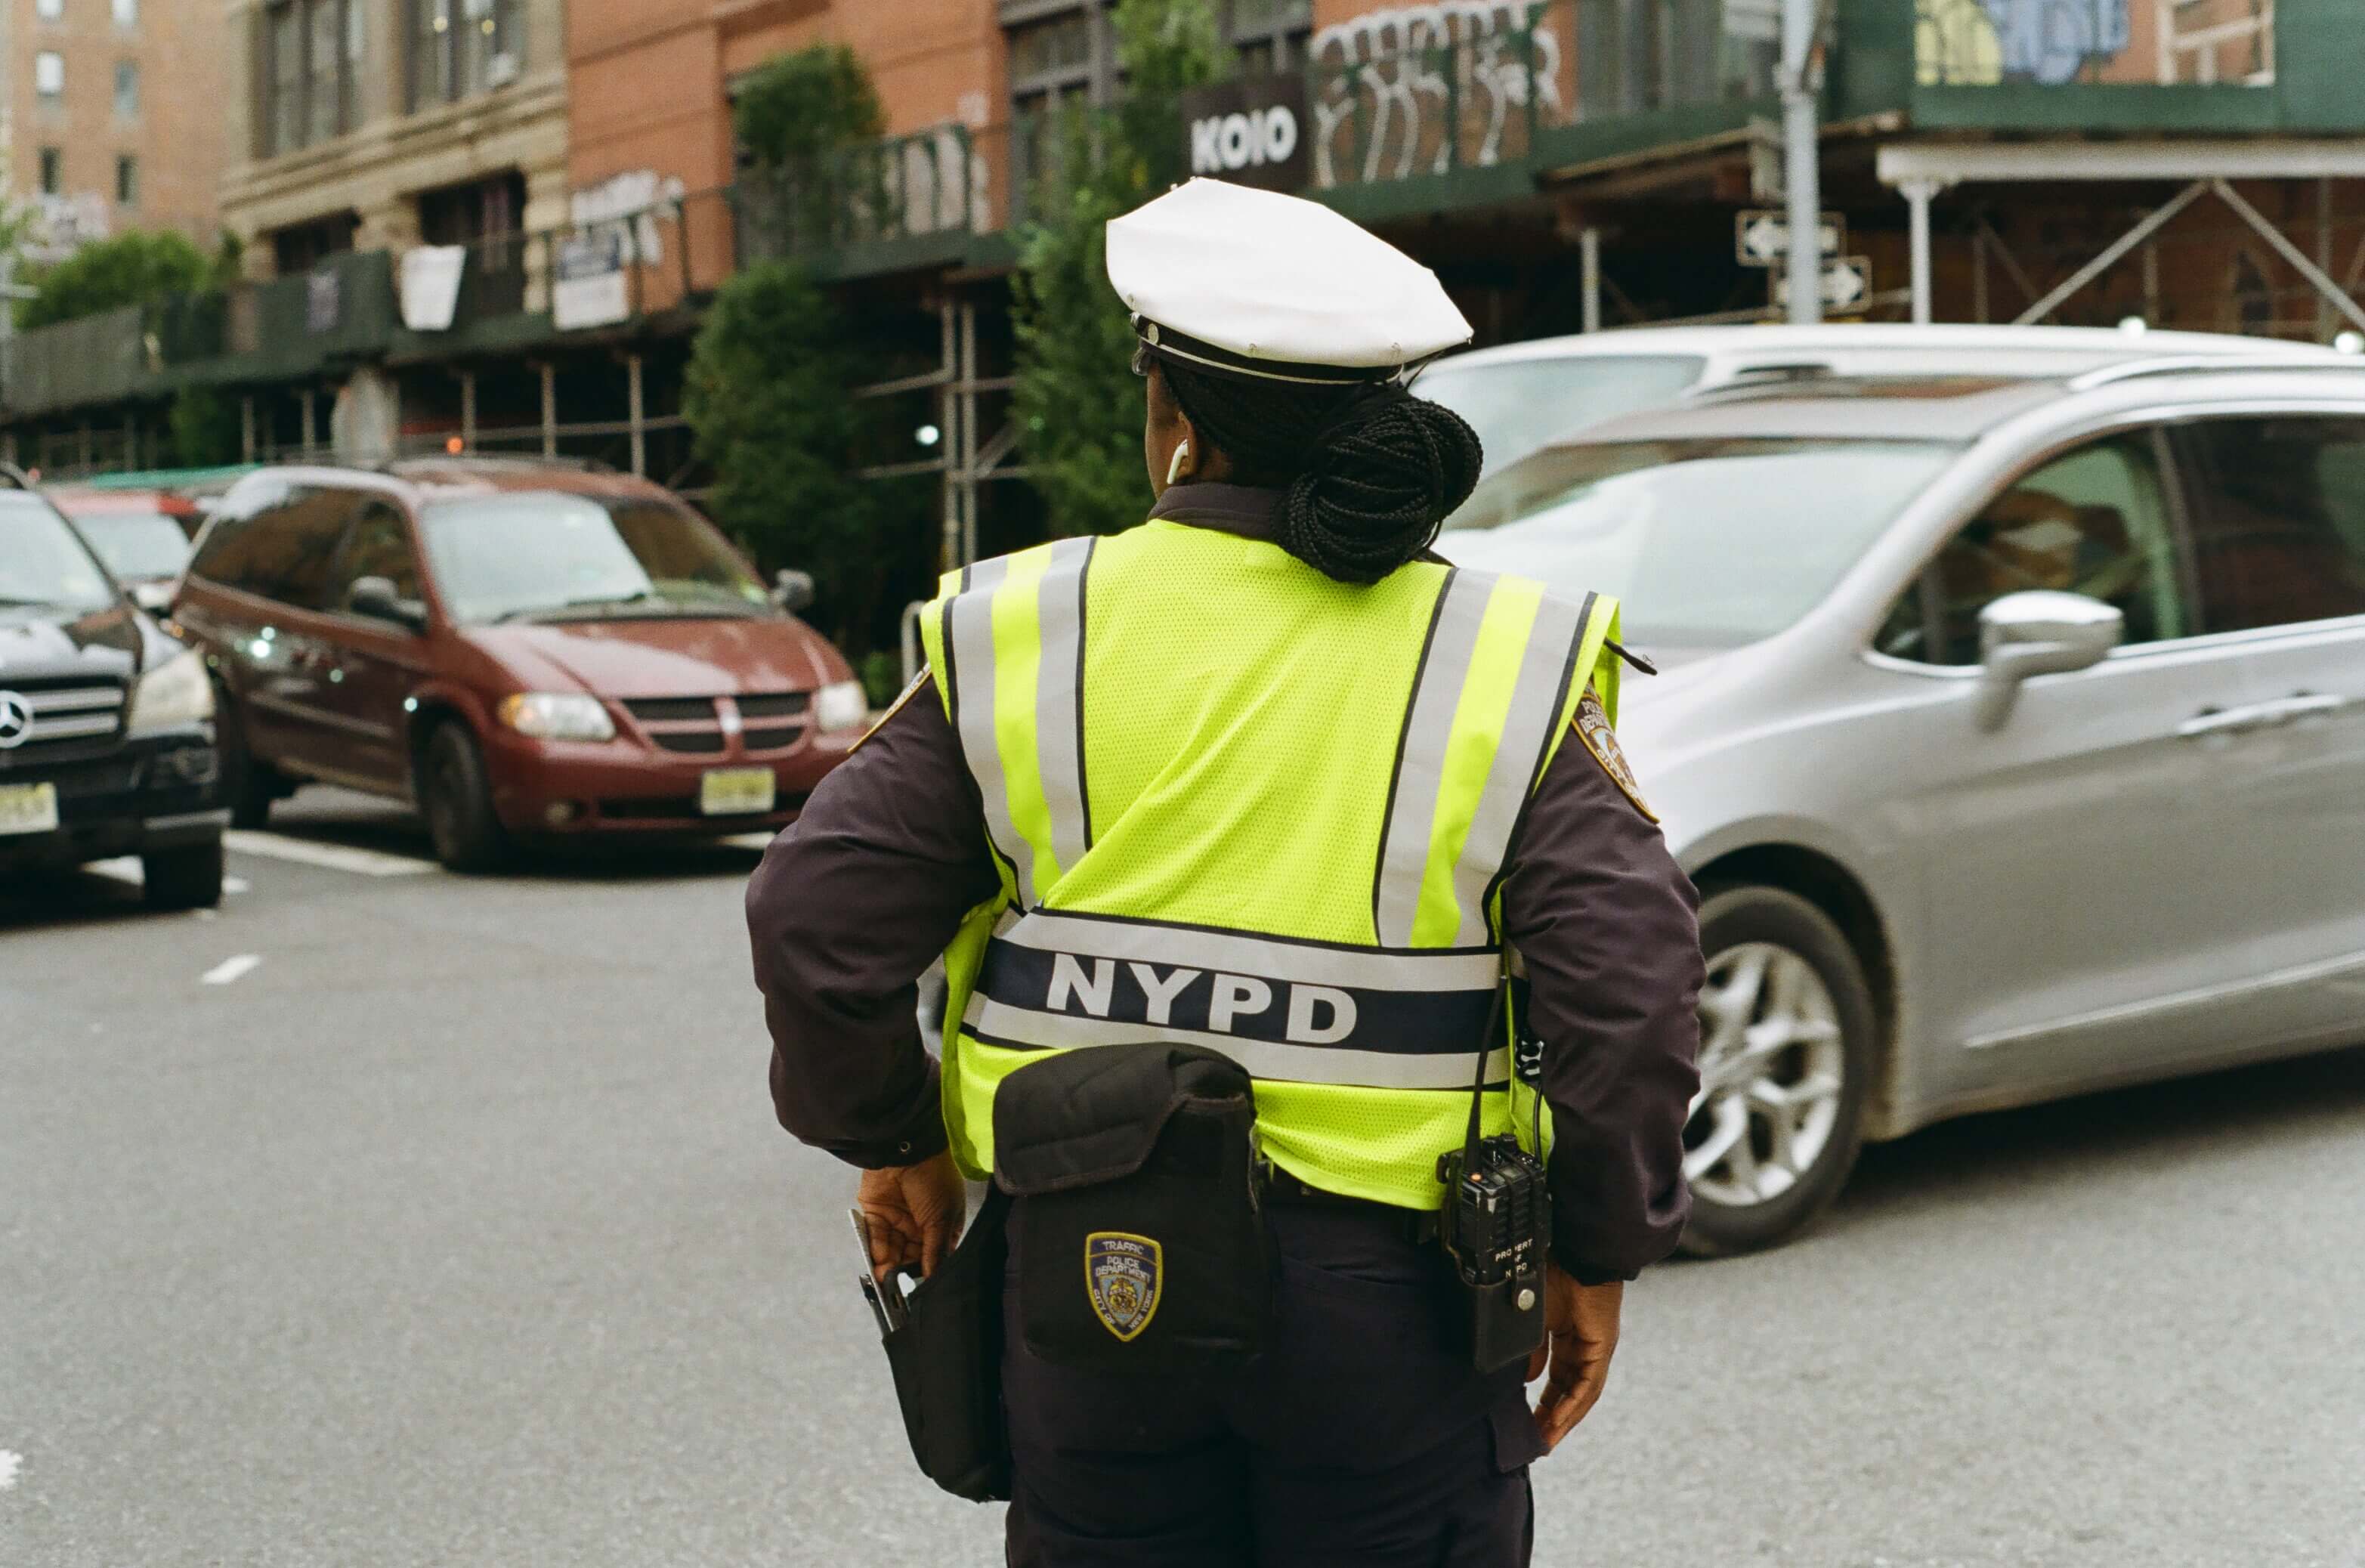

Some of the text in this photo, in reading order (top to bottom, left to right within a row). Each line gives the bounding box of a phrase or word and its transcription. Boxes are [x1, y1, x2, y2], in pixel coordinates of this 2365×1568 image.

[1191, 106, 1297, 173] KOIO
[1046, 953, 1357, 1044] NYPD
[1102, 1240, 1145, 1255] TRAFFIC
[1106, 1256, 1140, 1270] POLICE
[1505, 1262, 1527, 1279] NPD
[1095, 1264, 1152, 1282] DEPARTMENT
[1094, 1288, 1107, 1311] CITY
[1128, 1313, 1144, 1330] NEW
